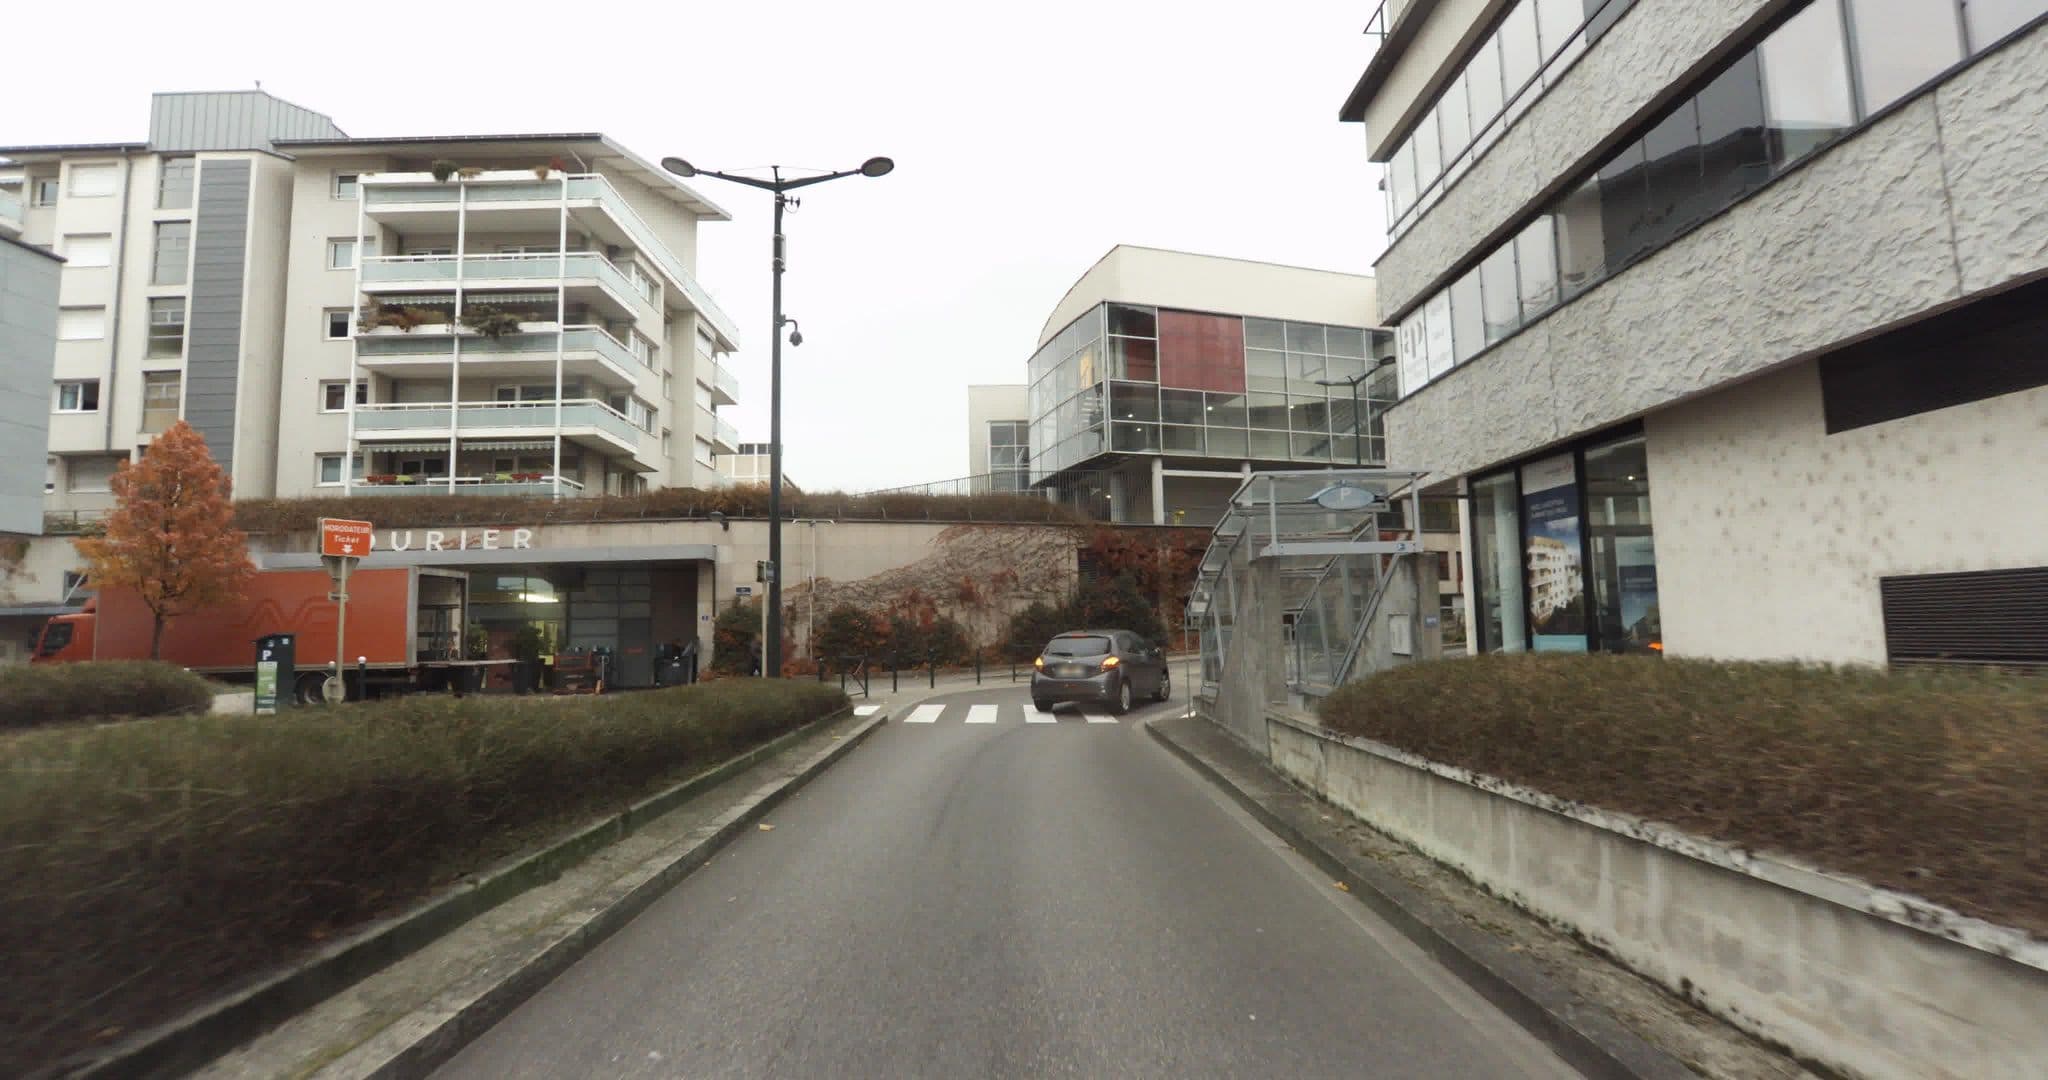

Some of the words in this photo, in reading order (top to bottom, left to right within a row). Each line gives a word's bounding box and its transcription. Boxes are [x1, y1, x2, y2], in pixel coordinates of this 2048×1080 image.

[334, 535, 359, 544] Ticket
[370, 529, 532, 551] URIER
[262, 649, 273, 661] P
